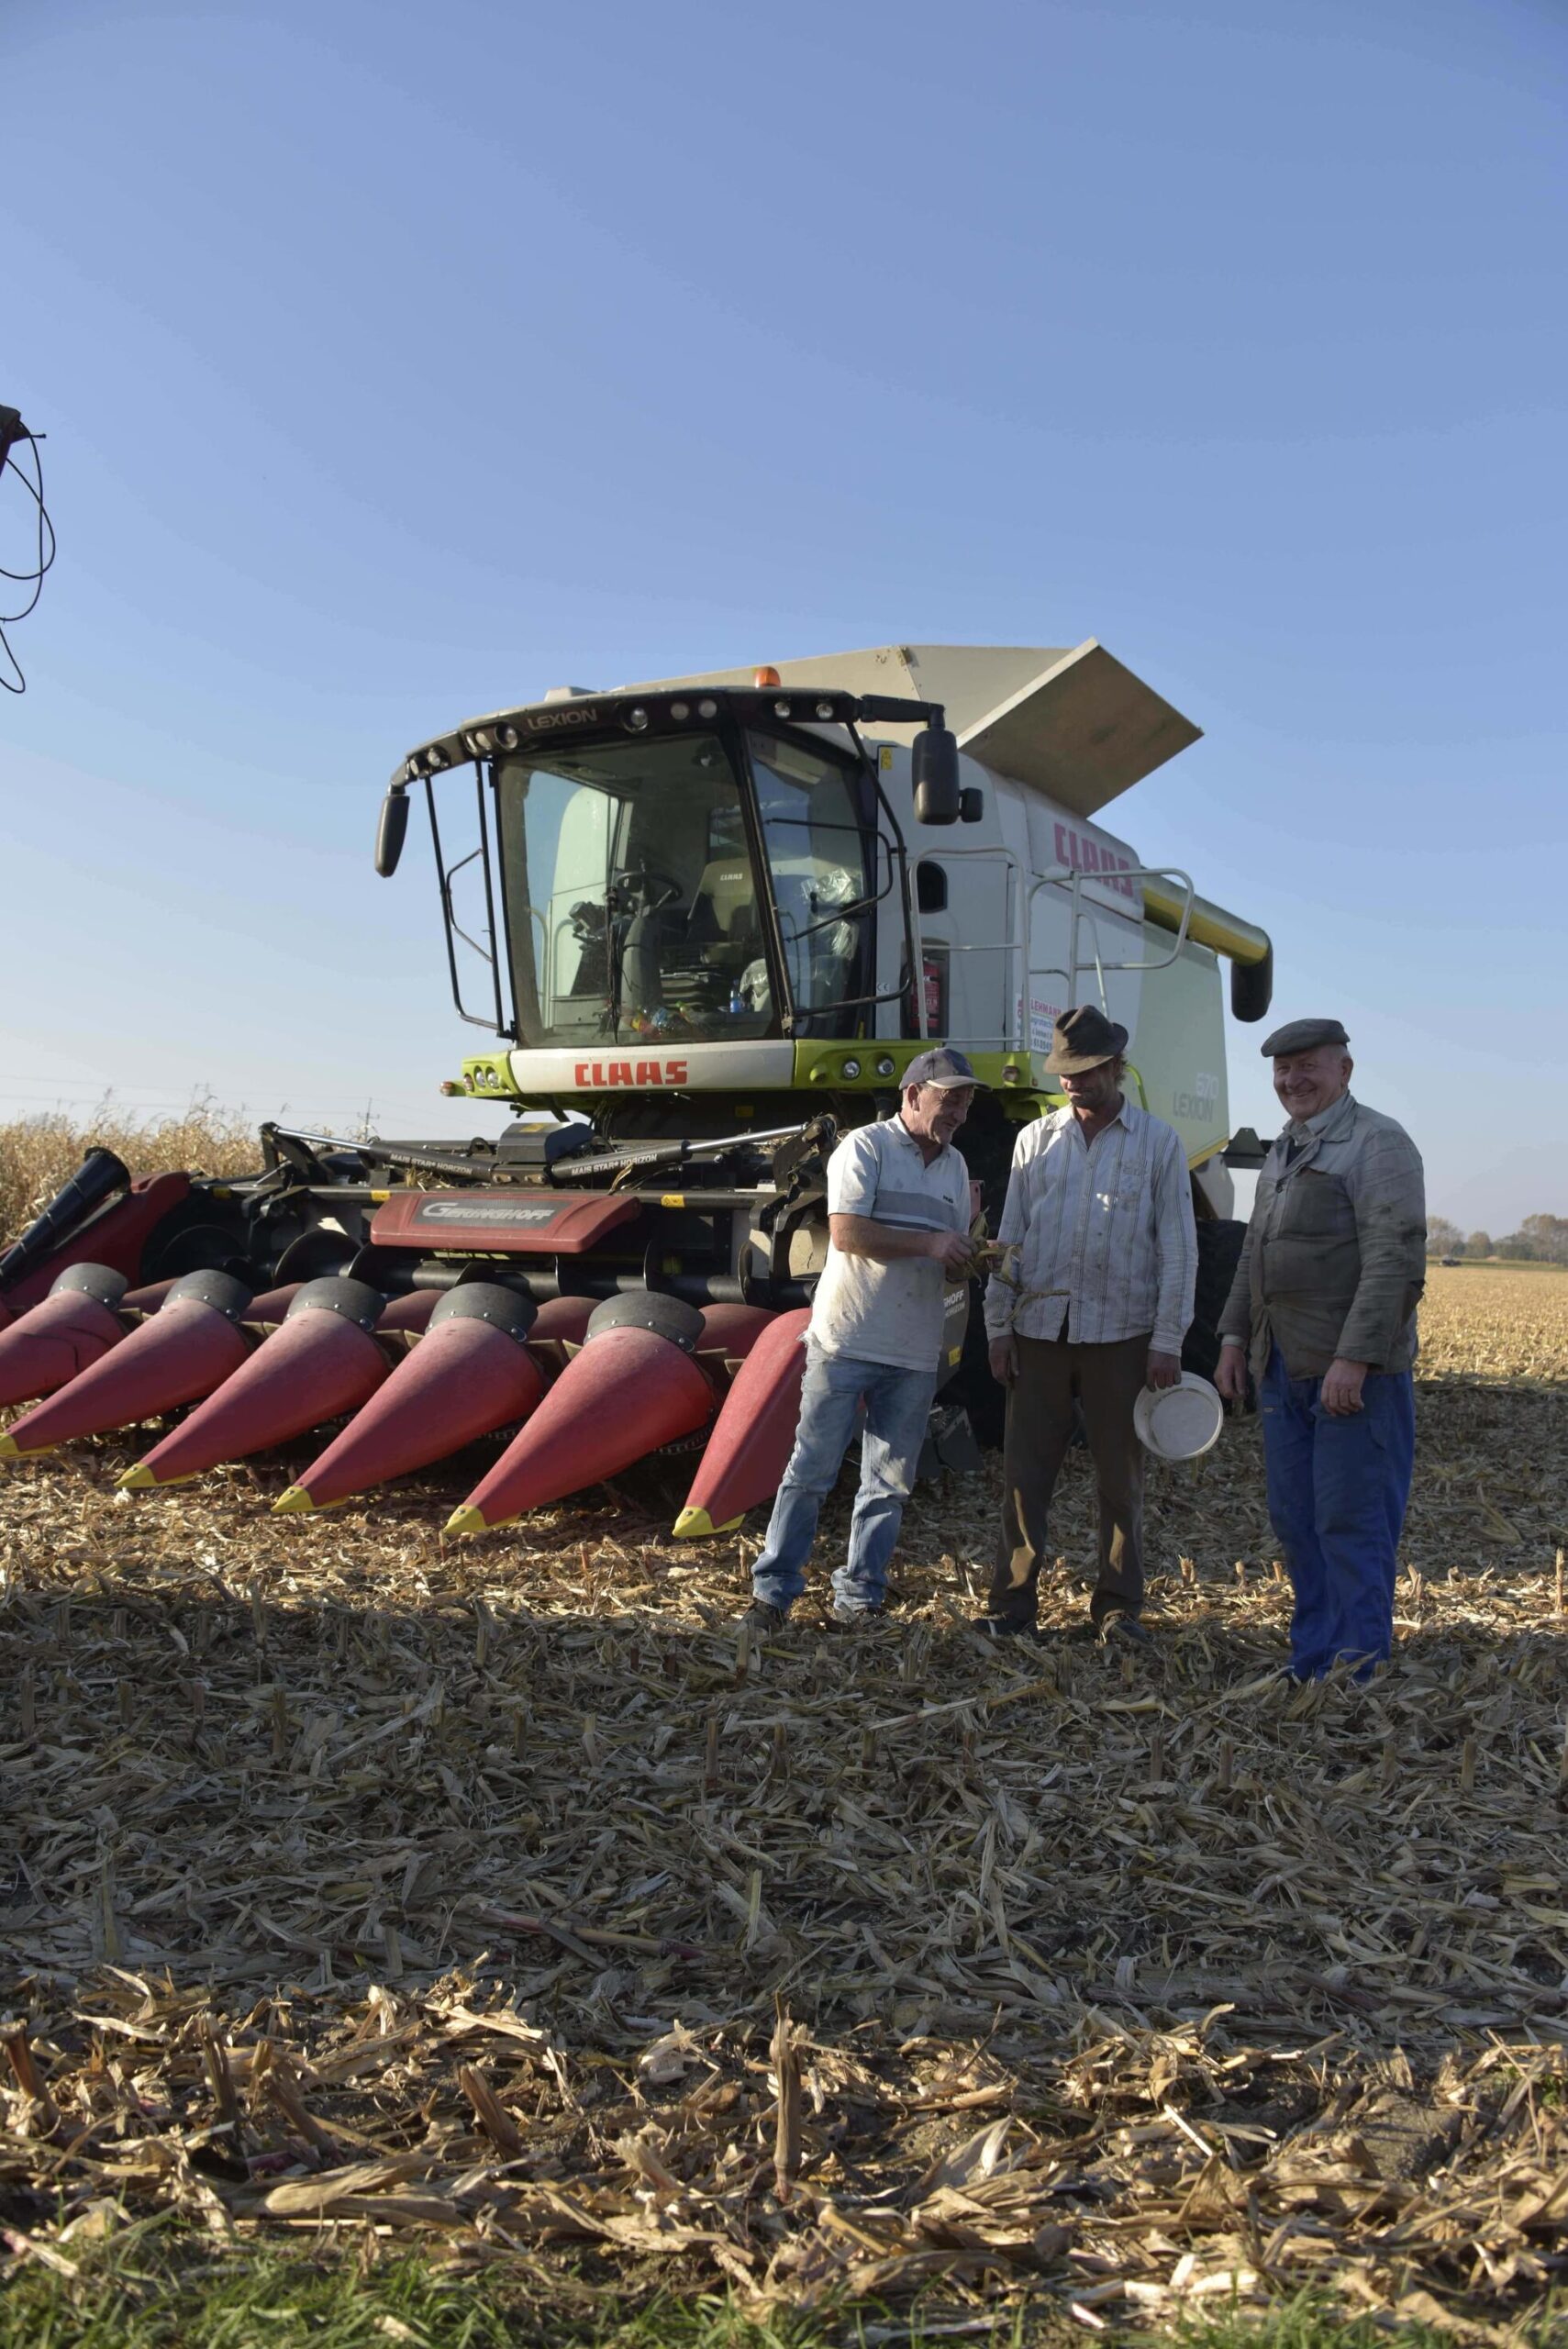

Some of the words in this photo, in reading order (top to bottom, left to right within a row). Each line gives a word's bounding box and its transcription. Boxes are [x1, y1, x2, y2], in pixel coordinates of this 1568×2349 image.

[527, 708, 598, 730] LEXION
[1054, 822, 1134, 898] CLAAS
[574, 1061, 688, 1087] CLAAS
[1173, 1091, 1214, 1123] LEXION
[390, 1152, 411, 1164] MAIS
[437, 1162, 473, 1175] HORIZON
[572, 1164, 593, 1176] MAIS
[620, 1153, 658, 1168] HORIZON
